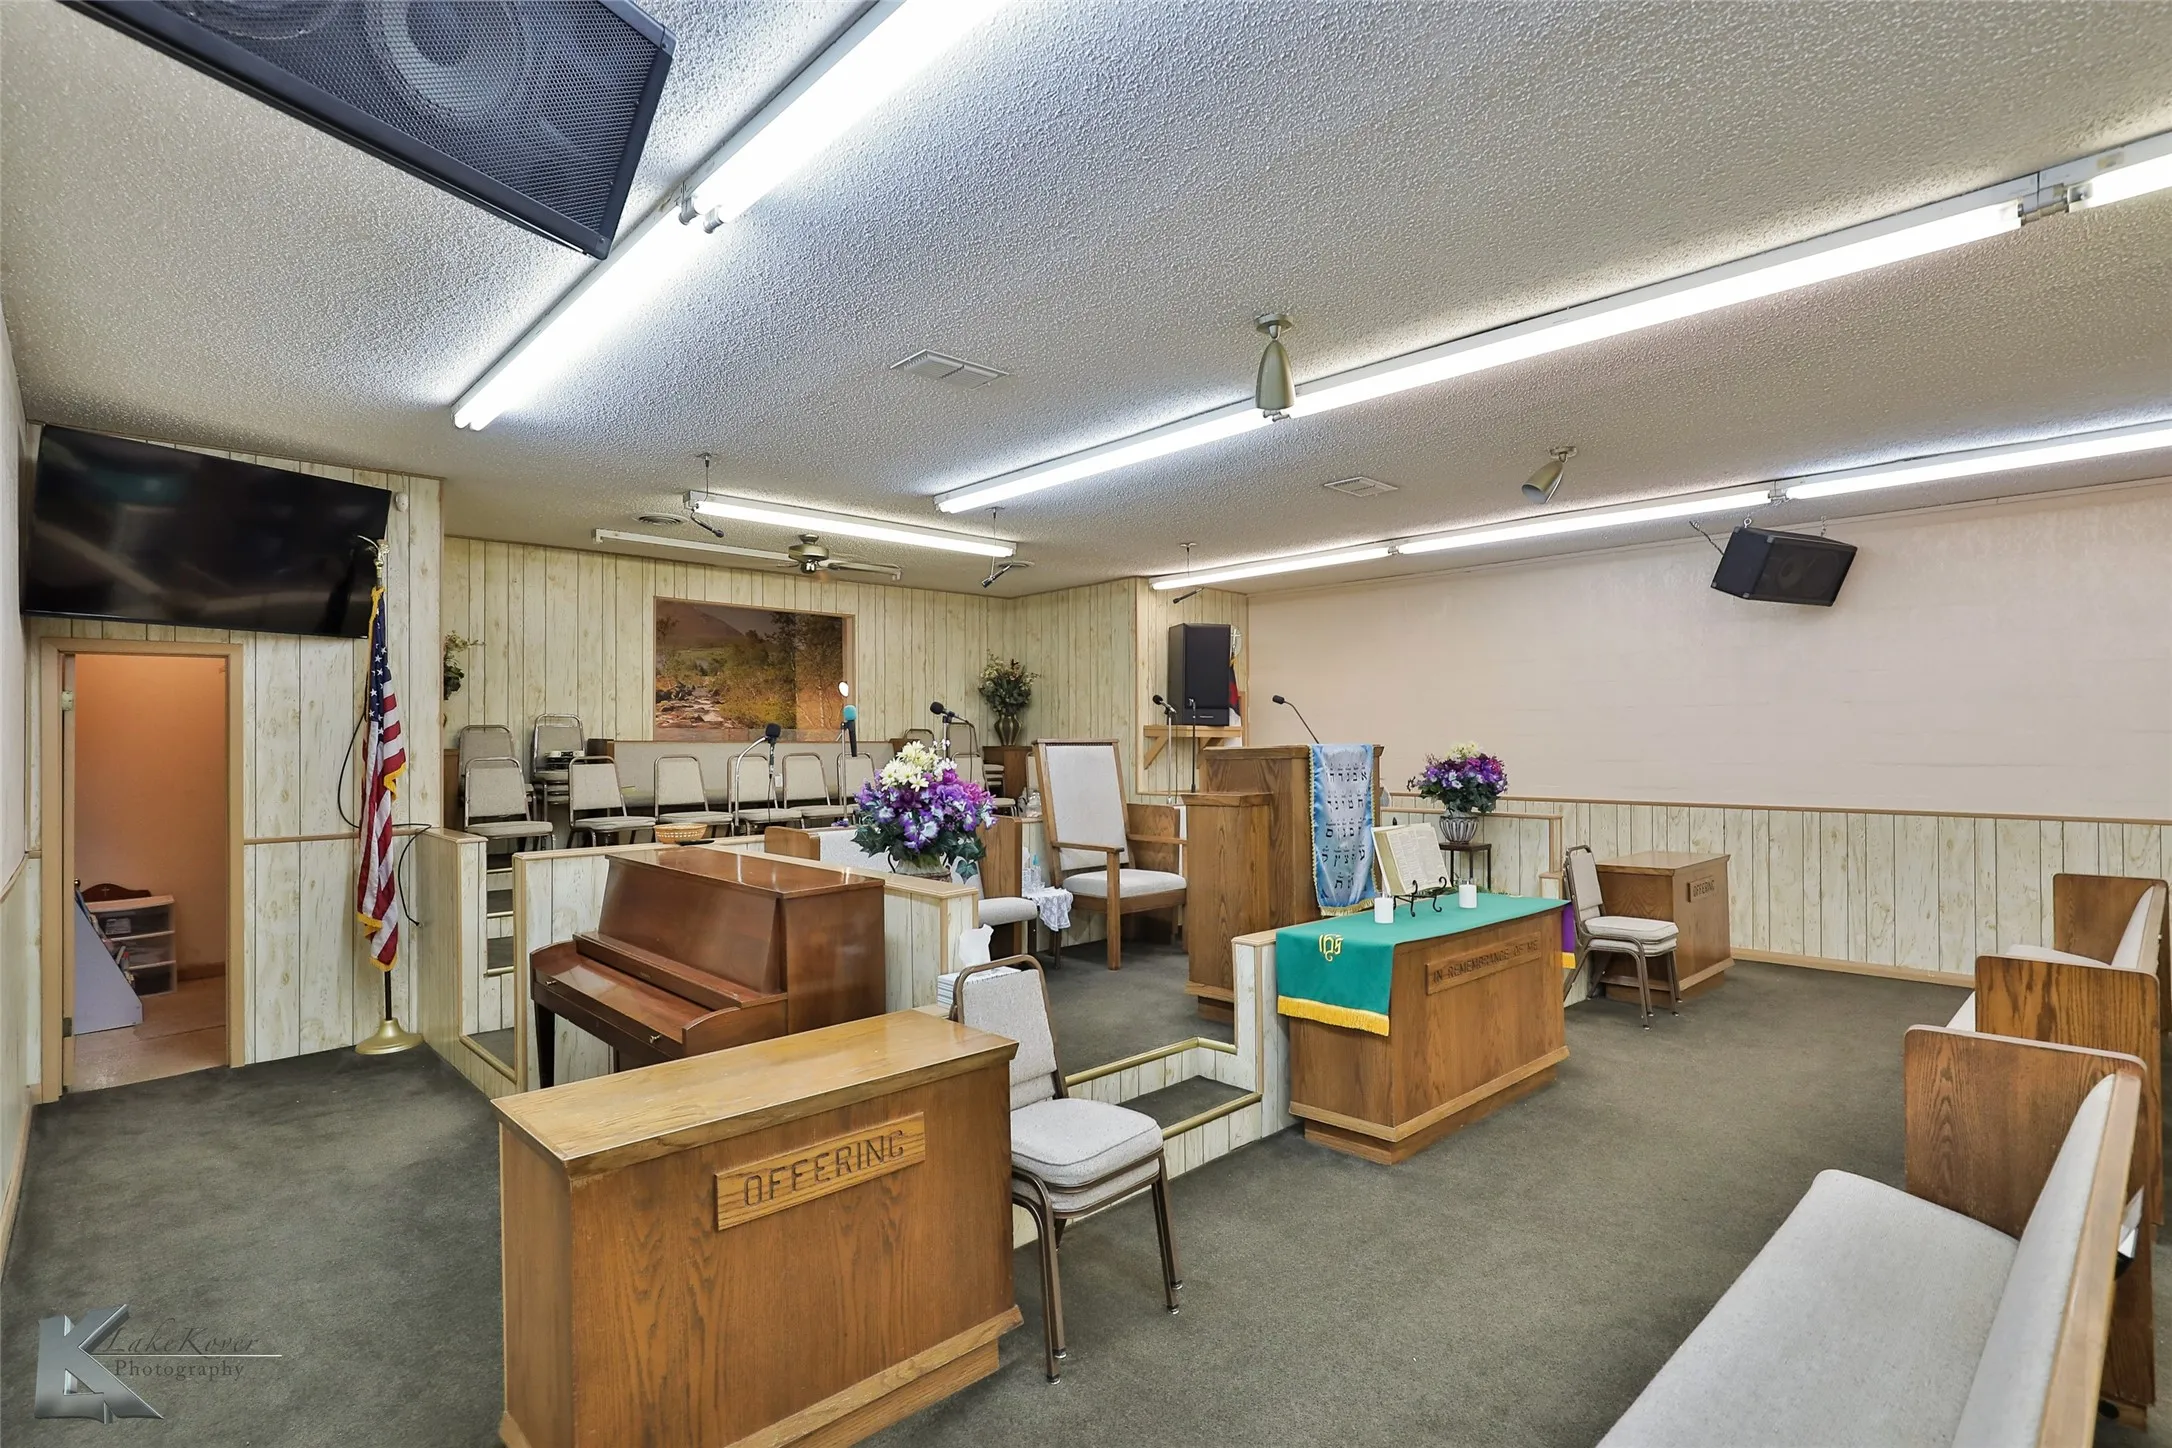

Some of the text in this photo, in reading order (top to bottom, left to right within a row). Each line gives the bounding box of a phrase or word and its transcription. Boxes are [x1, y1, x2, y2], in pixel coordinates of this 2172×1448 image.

[1433, 939, 1539, 984] IN REMEMBRANCE OF ME
[743, 1130, 904, 1209] OFFERING
